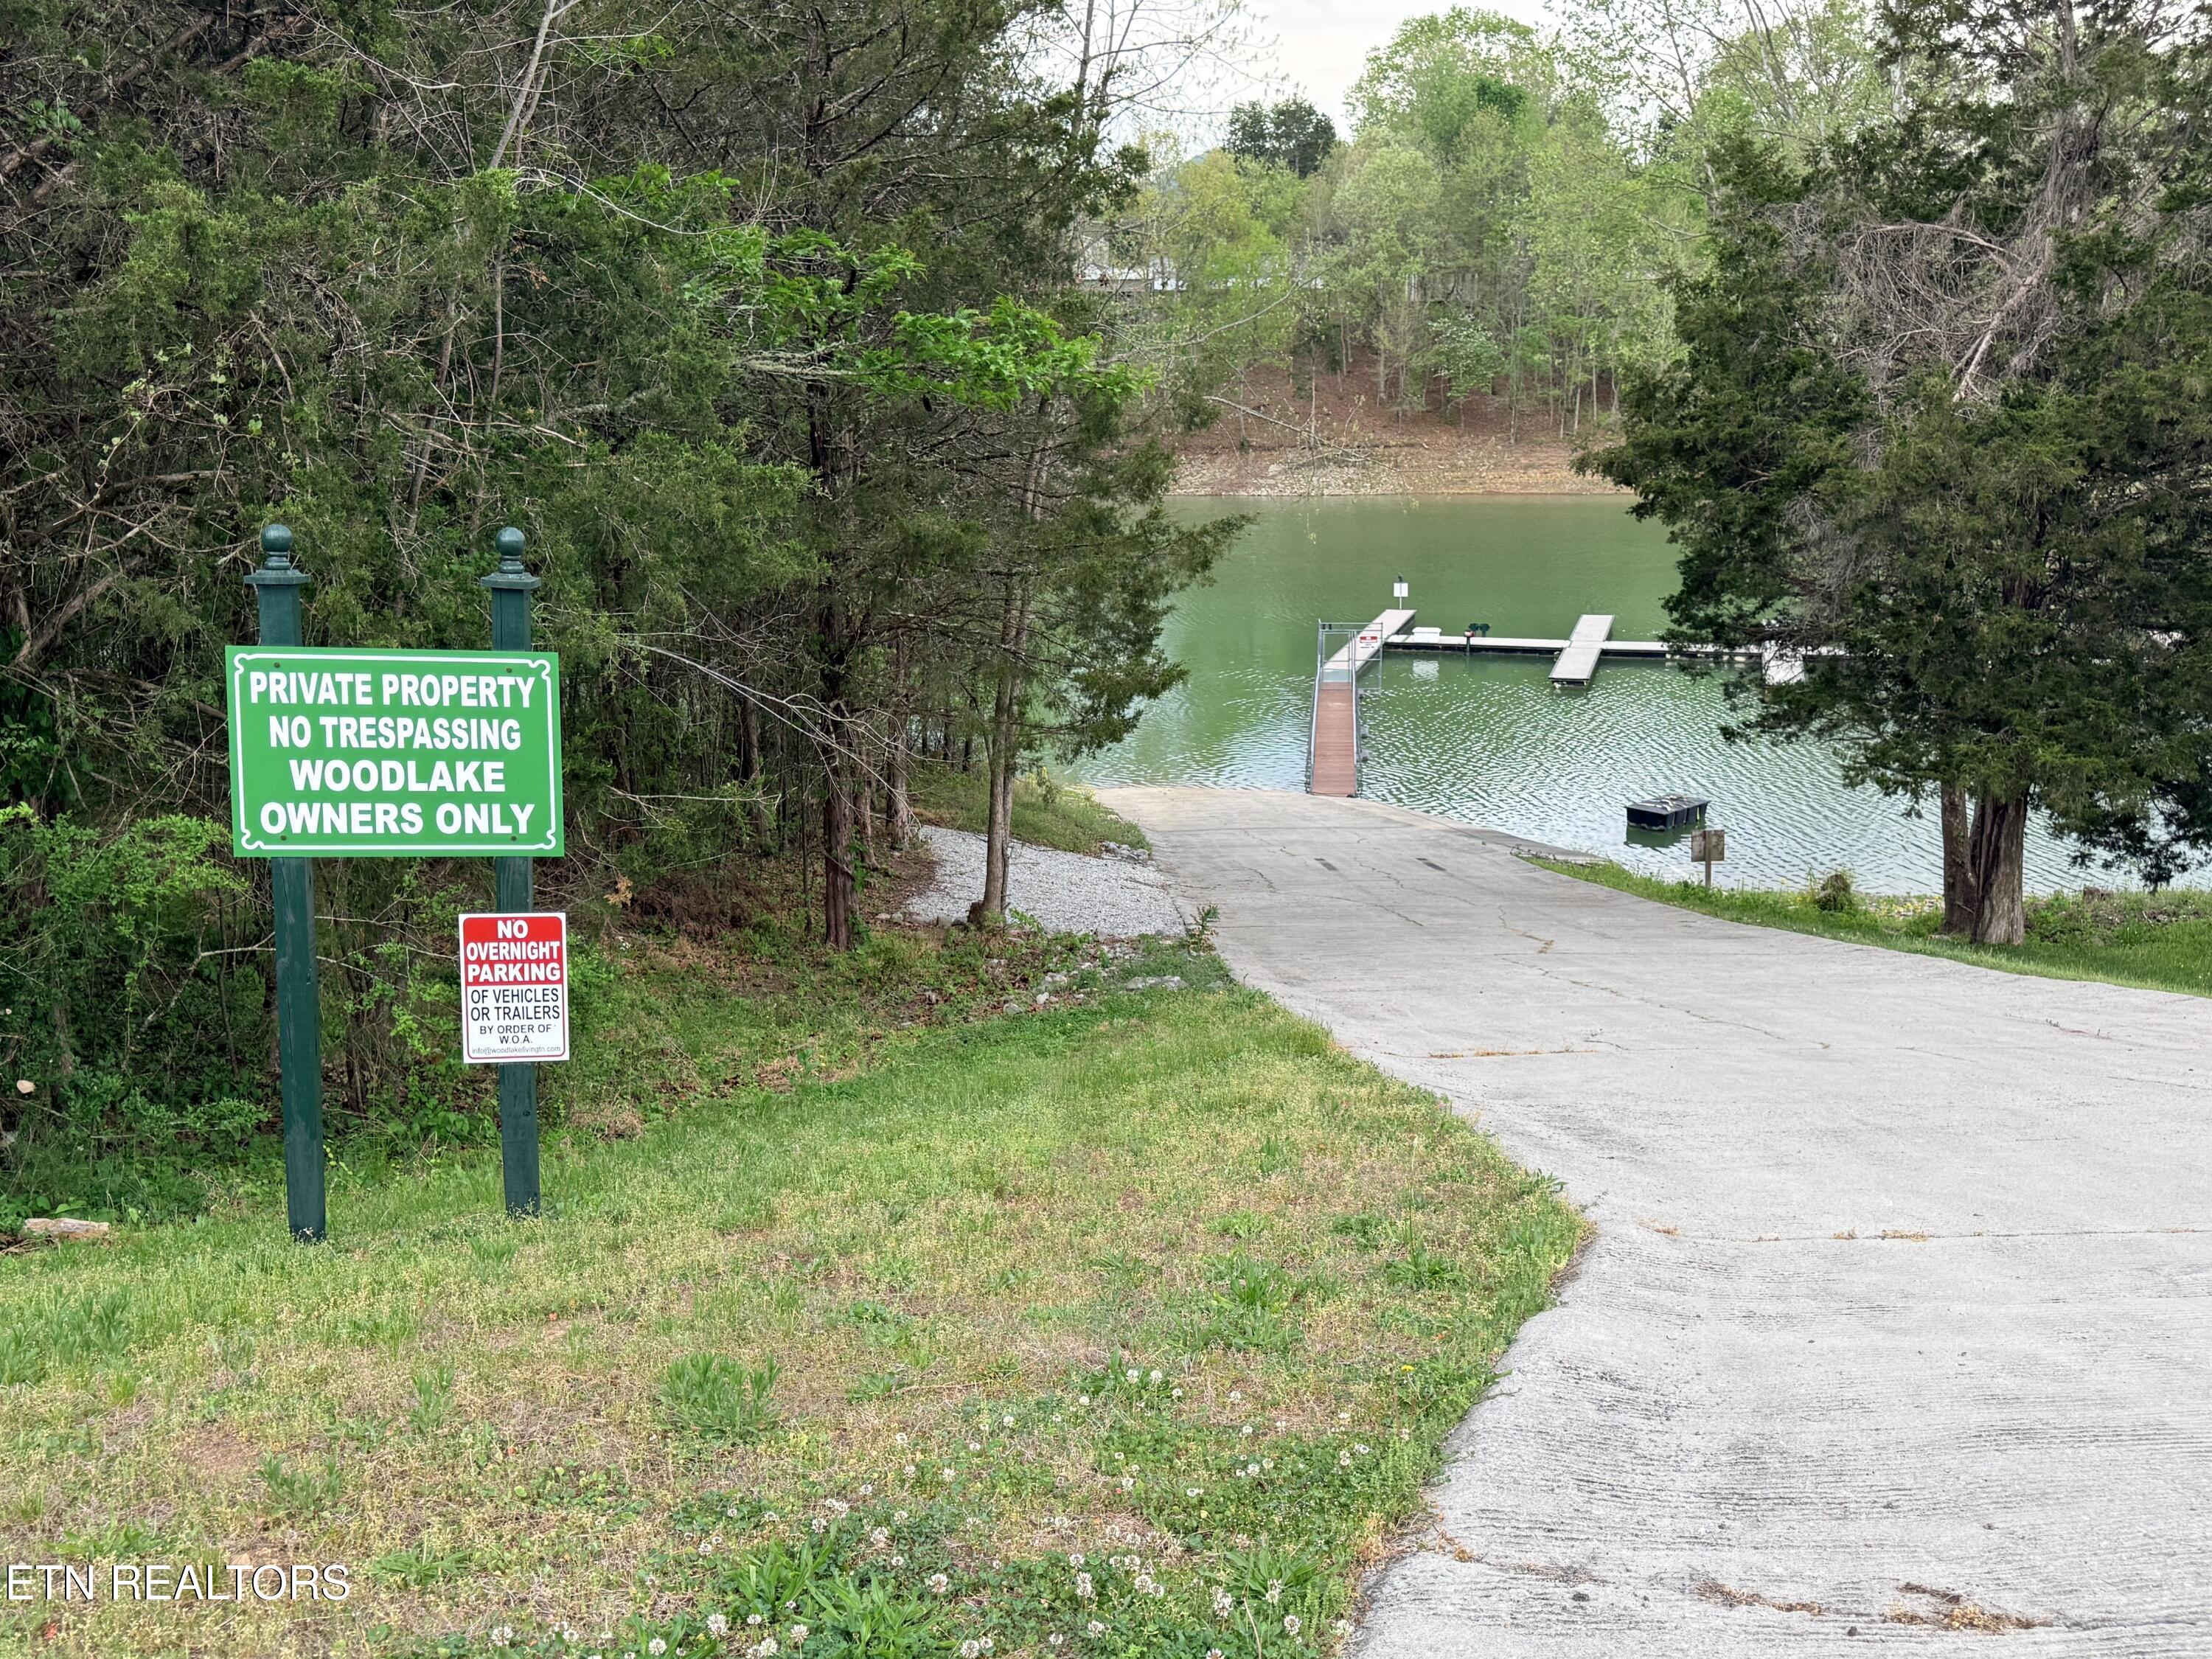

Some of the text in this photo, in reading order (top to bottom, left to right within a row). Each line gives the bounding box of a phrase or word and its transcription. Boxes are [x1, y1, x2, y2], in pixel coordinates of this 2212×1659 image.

[250, 672, 535, 709] PRIVATE PROPERTY
[269, 715, 521, 751] NO TRESPASSING
[289, 759, 506, 792] WOODLAKE
[260, 801, 535, 835] OWNERS ONLY
[497, 919, 529, 939] NO
[466, 941, 560, 961] OVERNIGHT
[467, 962, 561, 983] PARKING
[471, 988, 559, 1004] OF VEHICLES
[470, 1005, 560, 1021] OR TRAILERS
[480, 1023, 552, 1034] BY ORDER OF
[499, 1034, 533, 1044] W.O.A.
